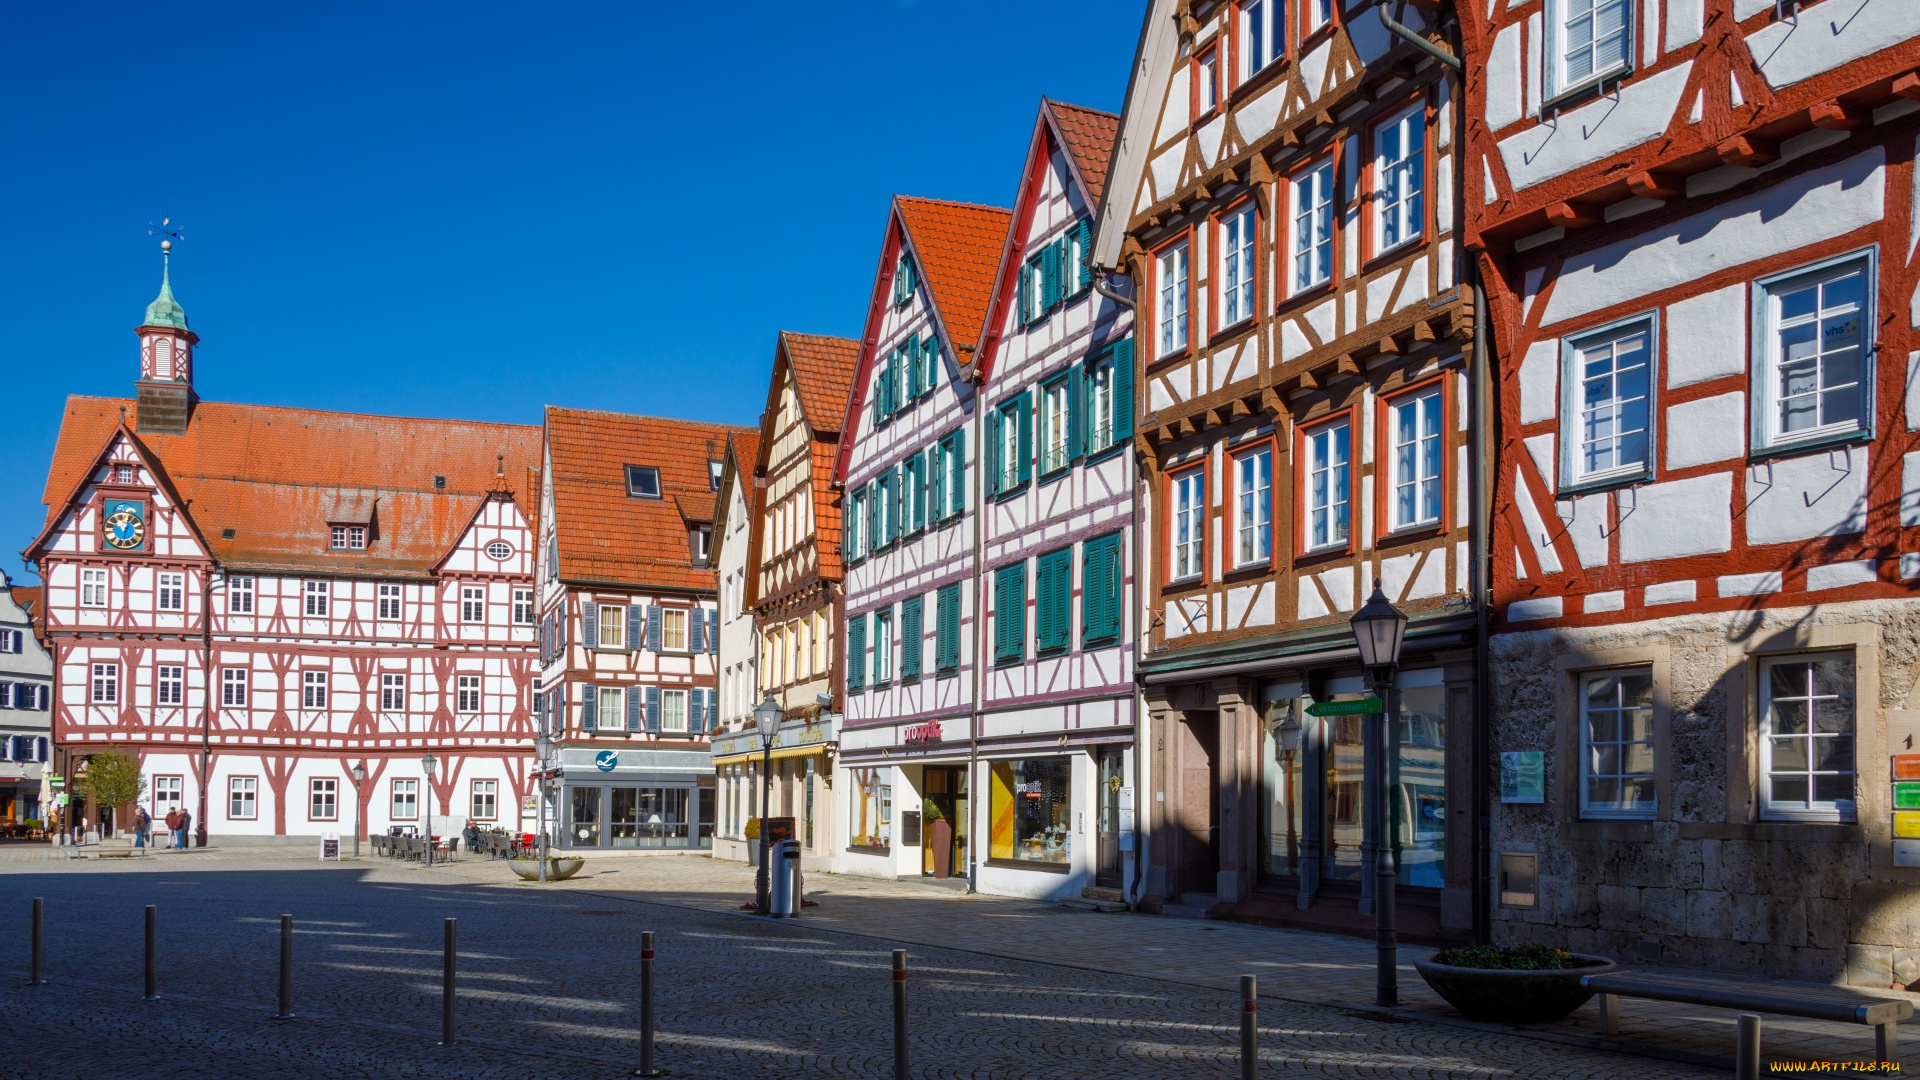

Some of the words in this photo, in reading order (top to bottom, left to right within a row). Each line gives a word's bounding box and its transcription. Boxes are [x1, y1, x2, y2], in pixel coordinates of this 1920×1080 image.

[1825, 326, 1844, 336] vhs
[1319, 703, 1368, 713] ENTDECKERWELT
[904, 718, 941, 744] prooptik
[1158, 738, 1163, 751] 2
[1902, 733, 1912, 750] 1
